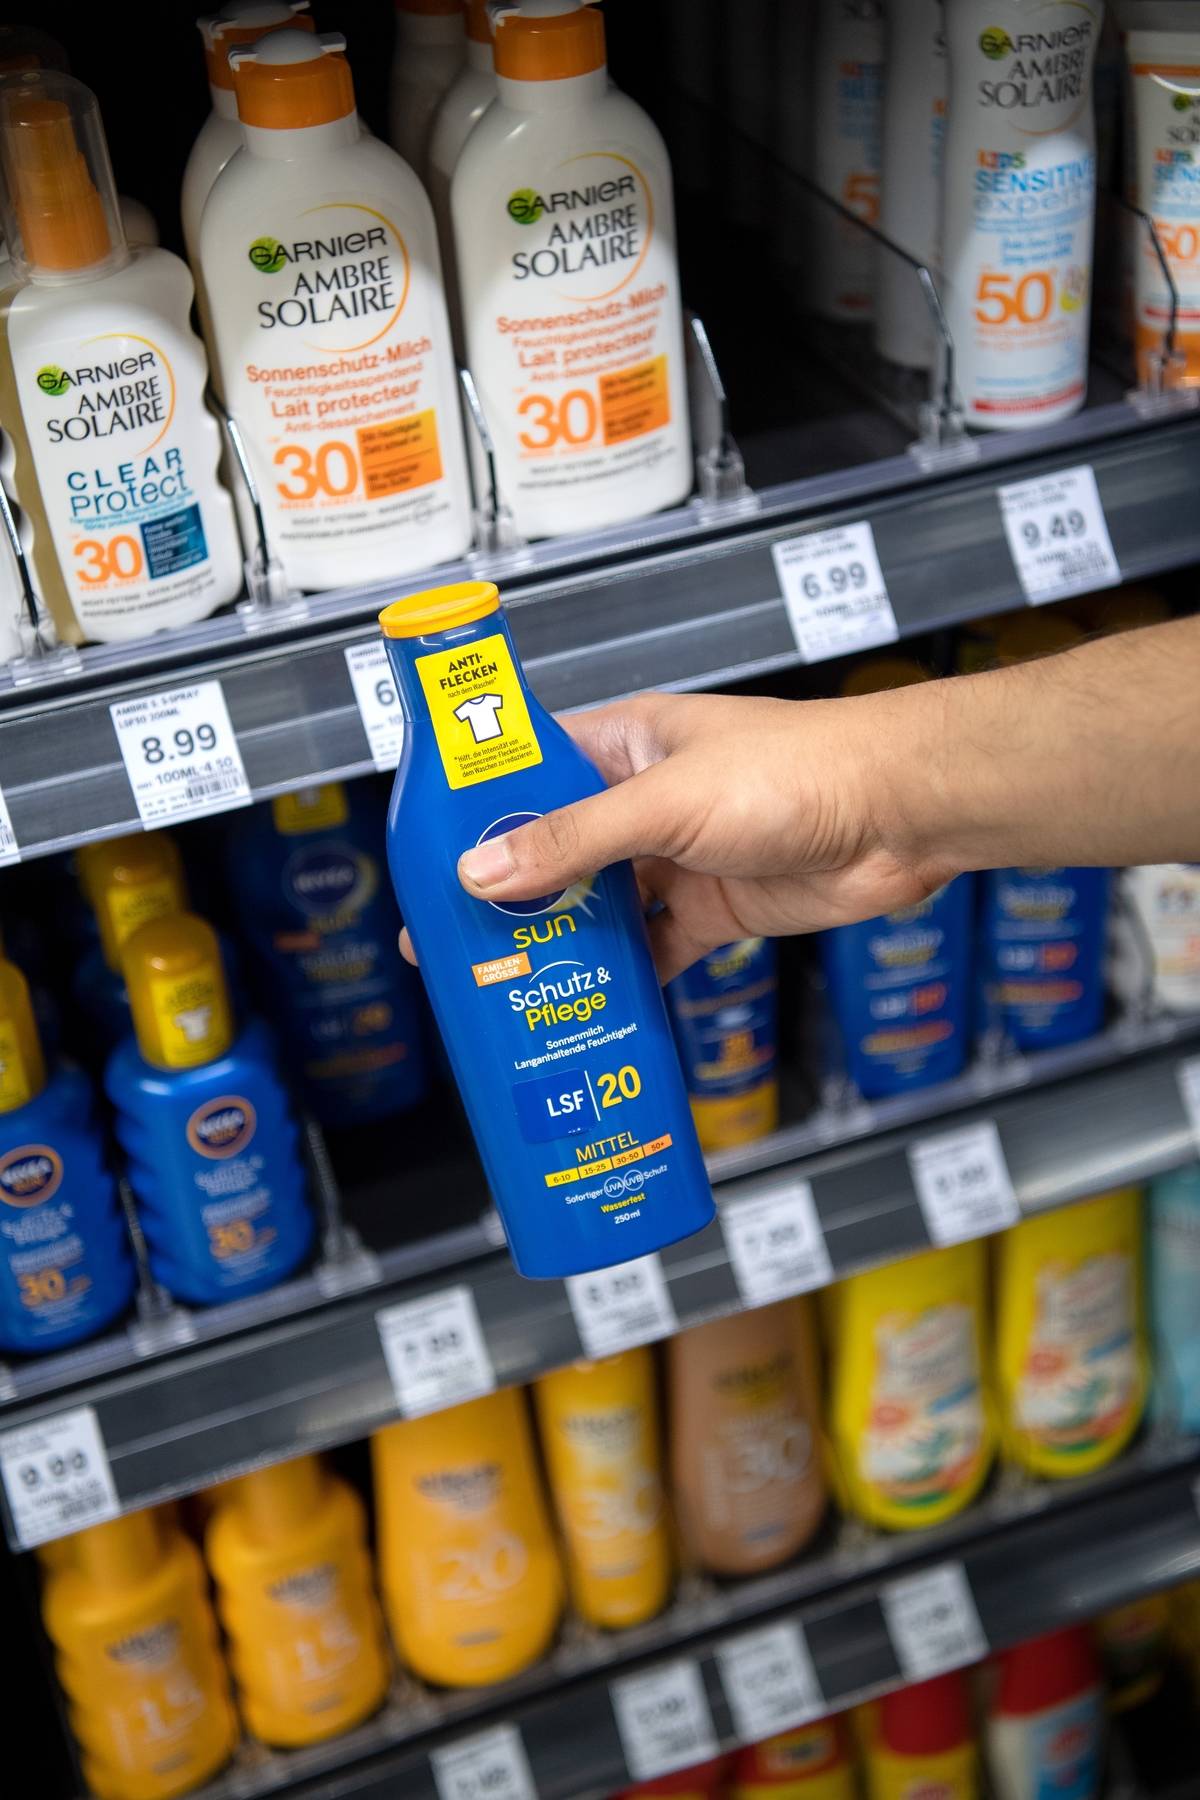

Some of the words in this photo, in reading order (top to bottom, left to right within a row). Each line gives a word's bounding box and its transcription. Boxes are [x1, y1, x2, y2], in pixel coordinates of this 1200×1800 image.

[506, 174, 636, 219] GARNIER
[548, 203, 639, 246] AMBRE
[248, 227, 388, 267] GARNIER
[511, 228, 640, 280] SOLAIRE
[293, 256, 392, 297] AMBRE
[258, 282, 396, 329] SOLAIRE
[37, 351, 157, 391] GARNIER
[246, 336, 433, 383] Sonnenschutz-Milch
[78, 375, 161, 415] AMBRE
[271, 401, 309, 419] Lait
[316, 380, 421, 418] protecteur
[47, 398, 166, 444] SOLAIRE
[517, 388, 598, 449] 30
[67, 447, 182, 492] CLEAR
[273, 441, 358, 501] 30
[71, 467, 188, 518] Protect
[74, 534, 143, 584] 30
[801, 561, 867, 601] 6.99
[439, 662, 498, 690] FLECKEN
[448, 653, 483, 673] ANTI-
[448, 687, 461, 699] nach
[461, 684, 473, 695] dem
[141, 723, 218, 765] 8.99
[513, 914, 577, 950] sun
[478, 957, 521, 976] FAMILIEN-
[508, 970, 596, 1012] Schutz
[596, 966, 611, 985] &
[525, 992, 607, 1032] Pflege
[514, 1043, 587, 1071] Langanhaltende
[587, 1022, 638, 1050] Feuchtigkeit
[546, 1024, 604, 1051] Sonnenmilch
[546, 1089, 584, 1118] LSF
[596, 1065, 642, 1110] 20
[552, 1173, 571, 1185] 6-10
[584, 1163, 607, 1176] 15-25
[616, 1152, 639, 1165] 30-50
[651, 1140, 665, 1152] 50+
[575, 1131, 640, 1163] MITTEL
[565, 1187, 604, 1205] Sofortiger
[605, 1182, 624, 1194] UVA
[643, 1164, 668, 1180] Schutz
[600, 1192, 646, 1214] Wasserfest
